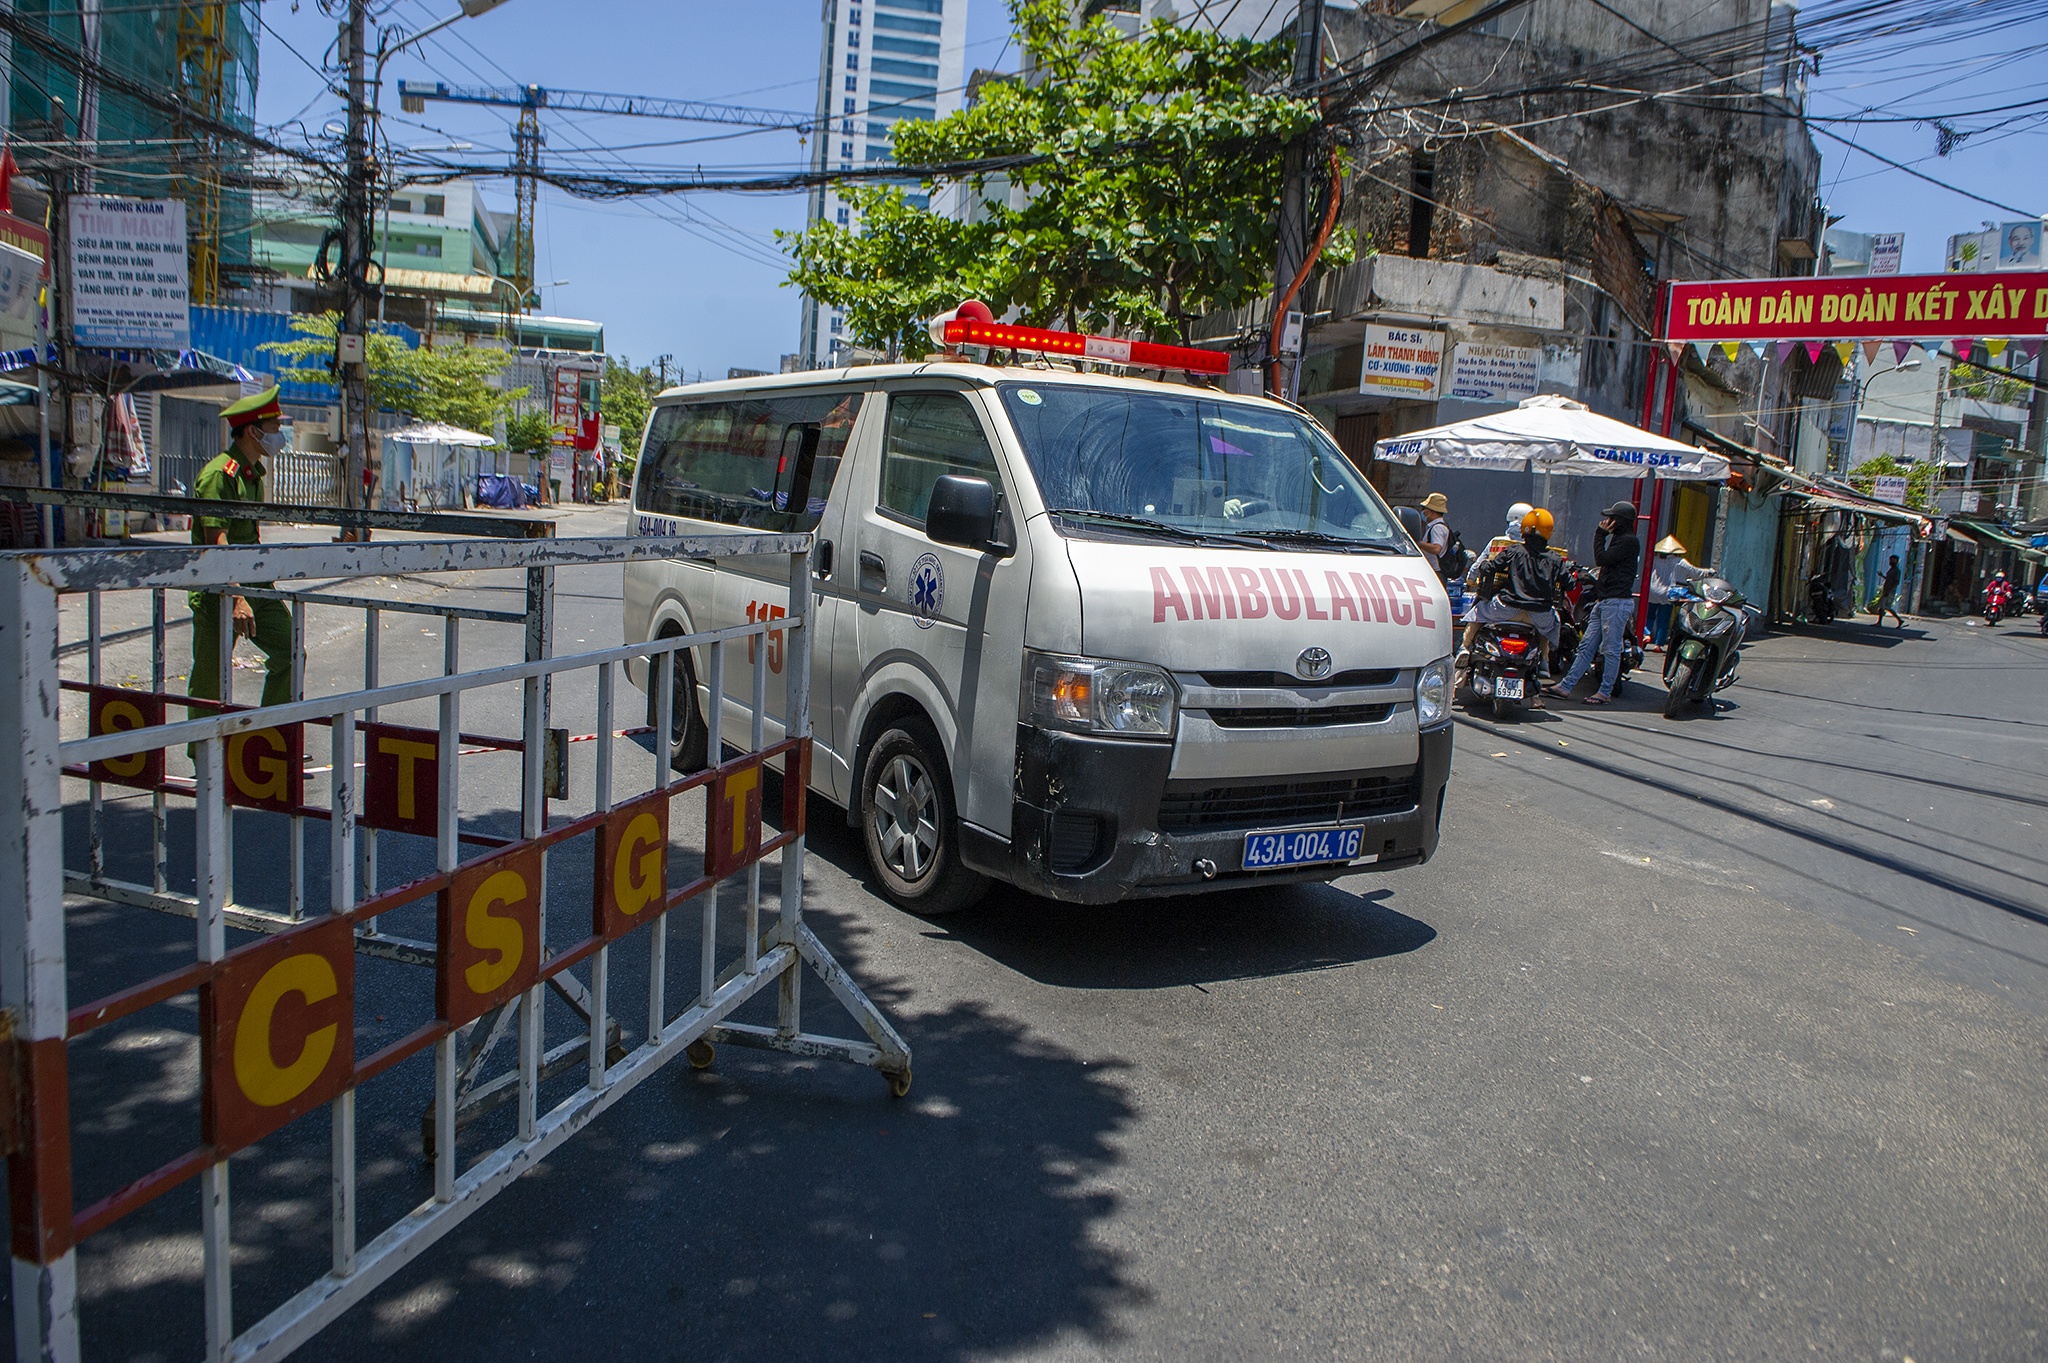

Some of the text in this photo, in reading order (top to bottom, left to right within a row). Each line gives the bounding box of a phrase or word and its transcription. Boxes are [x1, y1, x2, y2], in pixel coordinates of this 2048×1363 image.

[136, 201, 164, 214] KHÁM
[79, 214, 114, 236] TIM
[77, 237, 97, 250] SIÊU
[100, 237, 113, 250] ÂM
[117, 271, 133, 281] TIM
[157, 274, 178, 284] SINH
[1687, 291, 1752, 326] TOÀN
[1758, 289, 1814, 325] DÂN
[1820, 287, 1898, 324] ĐOÀN
[1905, 281, 1960, 321] KẾT
[1965, 282, 2027, 320] XÂY
[1388, 330, 1407, 343] BÁC
[1367, 342, 1386, 358] LÂM
[1388, 346, 1416, 361] THANH
[1468, 345, 1492, 358] NHẬN
[1386, 441, 1422, 457] POLICE
[1647, 452, 1683, 467] SÁT
[1149, 566, 1436, 629] AMBULANCE
[1247, 829, 1360, 865] 43A-004.16
